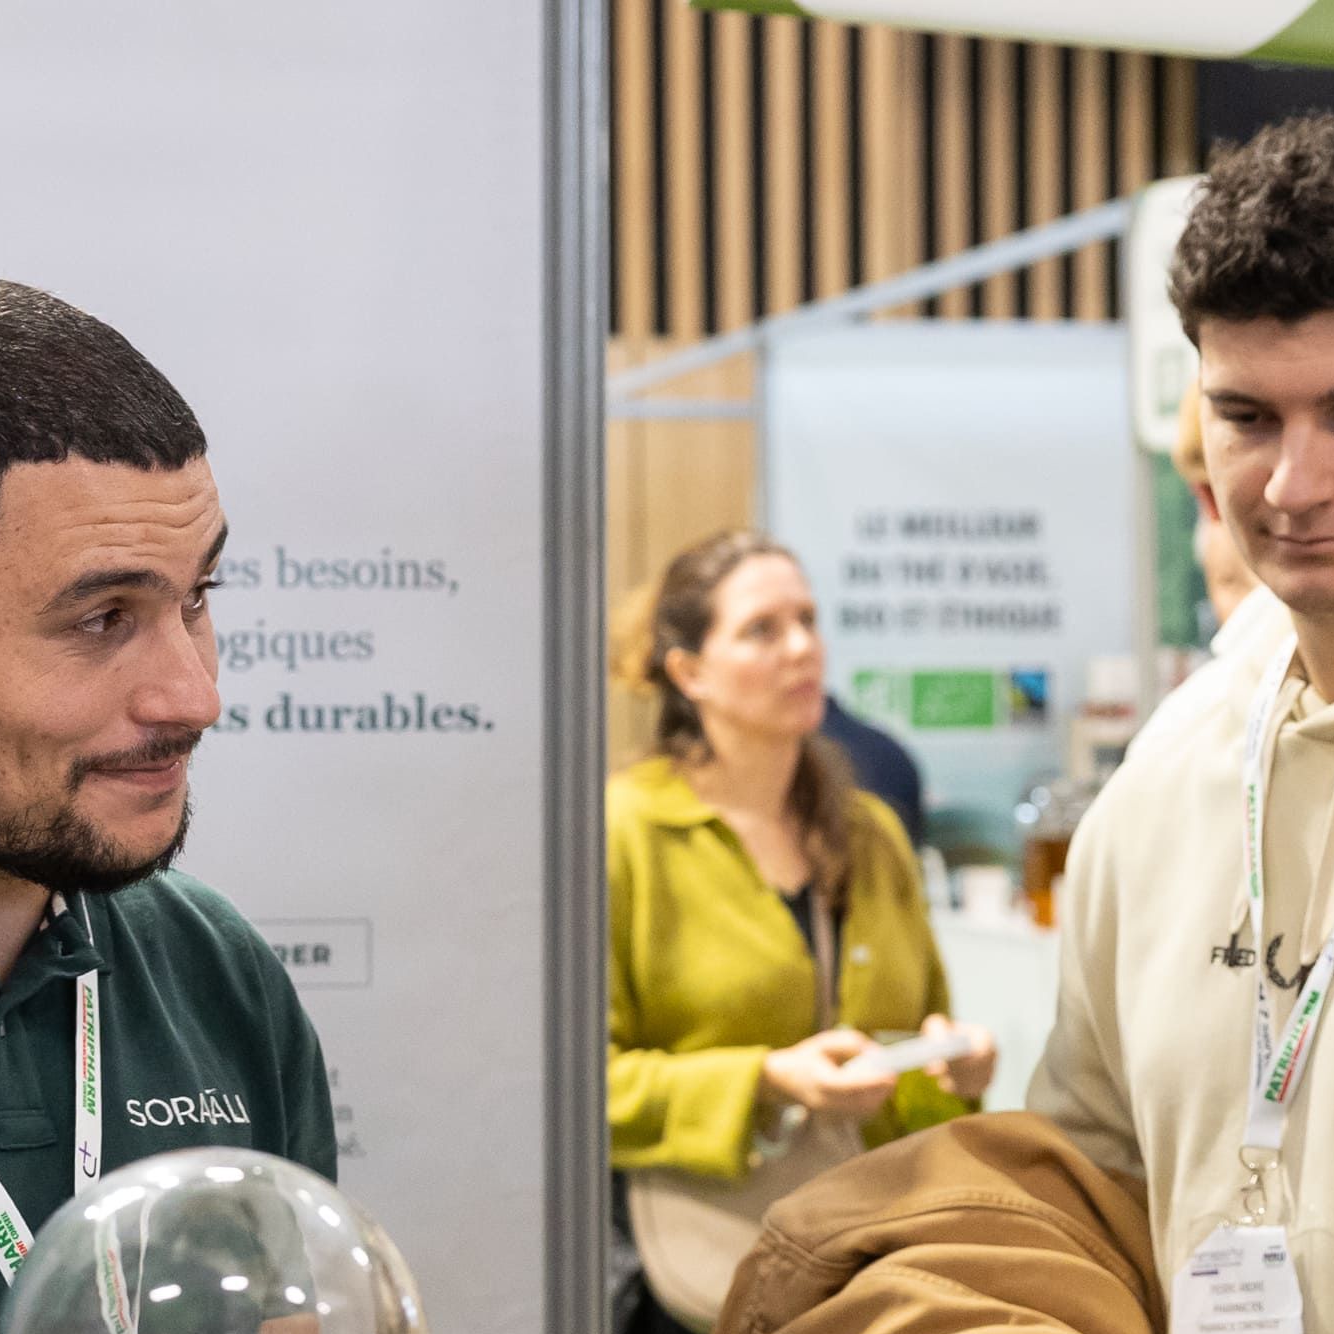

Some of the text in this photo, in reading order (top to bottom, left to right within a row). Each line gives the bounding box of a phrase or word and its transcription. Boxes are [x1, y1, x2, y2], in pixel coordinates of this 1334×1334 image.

[275, 546, 459, 597] besoins,
[265, 692, 496, 733] durables.
[84, 985, 97, 1117] PATRIPHARM
